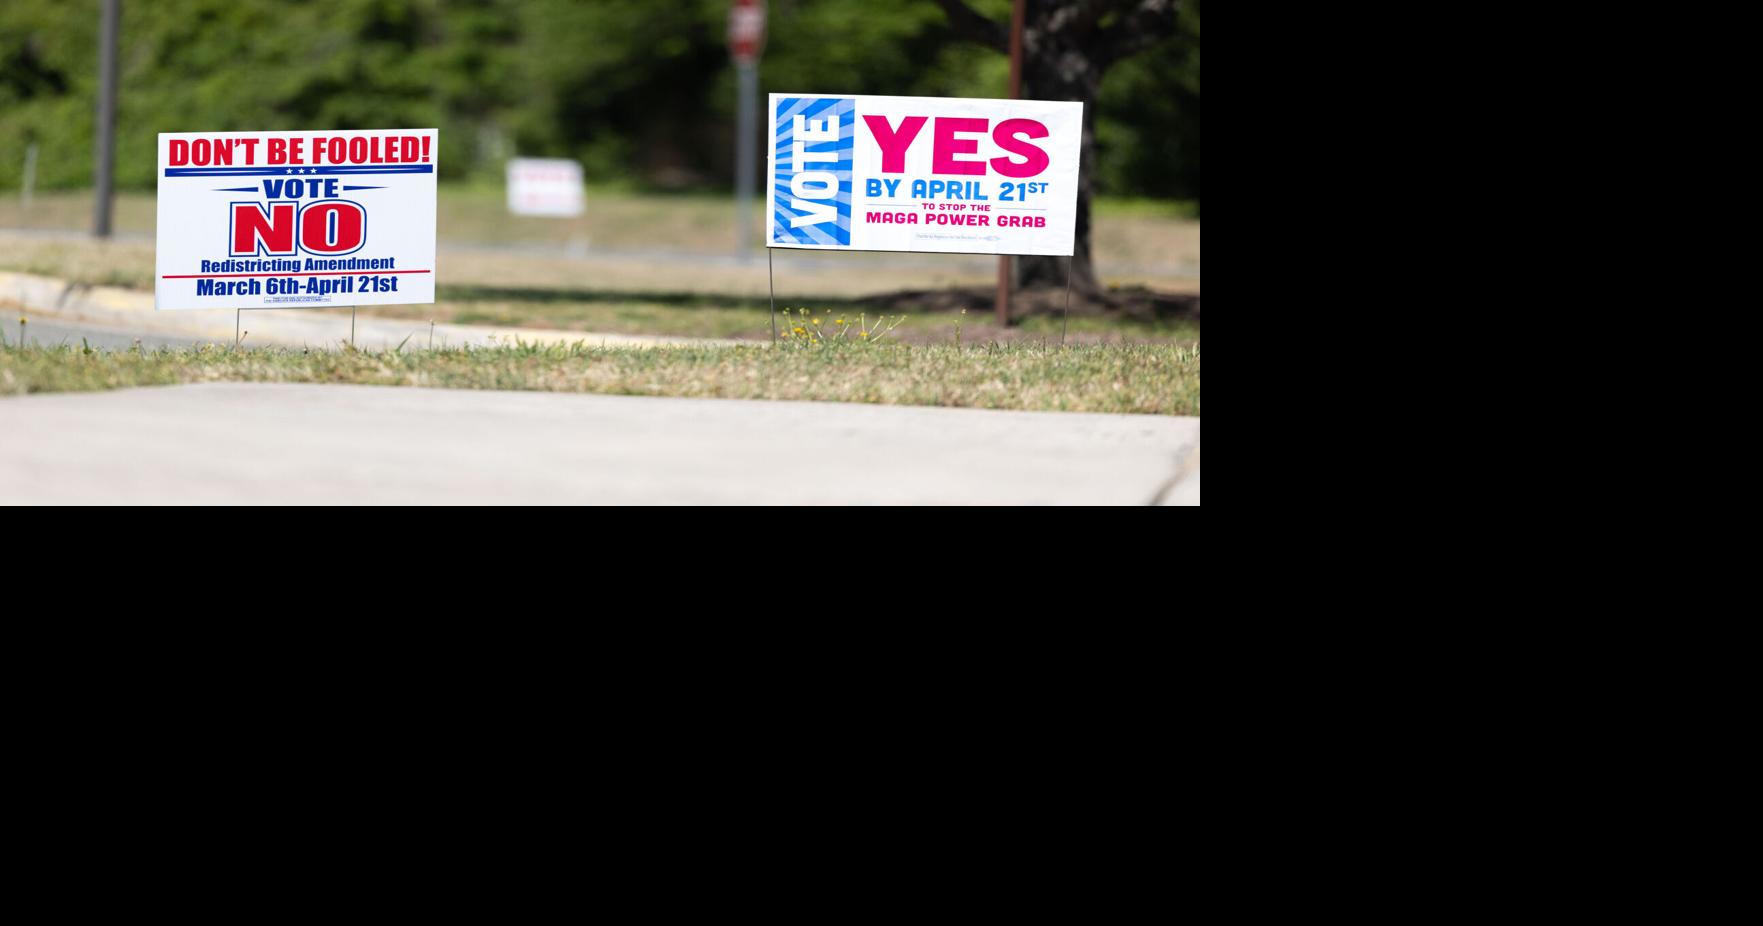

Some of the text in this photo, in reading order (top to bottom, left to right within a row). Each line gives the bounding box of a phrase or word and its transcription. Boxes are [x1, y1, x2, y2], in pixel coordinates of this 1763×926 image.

[169, 136, 431, 166] DON'T BE FOOLED!
[862, 114, 1050, 178] YES
[790, 114, 839, 228] VOTE
[263, 178, 339, 198] VOTE
[865, 178, 1049, 202] BY APRIL 21ST
[939, 203, 967, 211] STOP
[970, 204, 991, 212] THE
[229, 199, 367, 257] NO
[866, 212, 1046, 228] MAGA POWER GRAB
[201, 257, 395, 273] Redistricting Amendment
[196, 275, 398, 296] March 6th-April 21st
